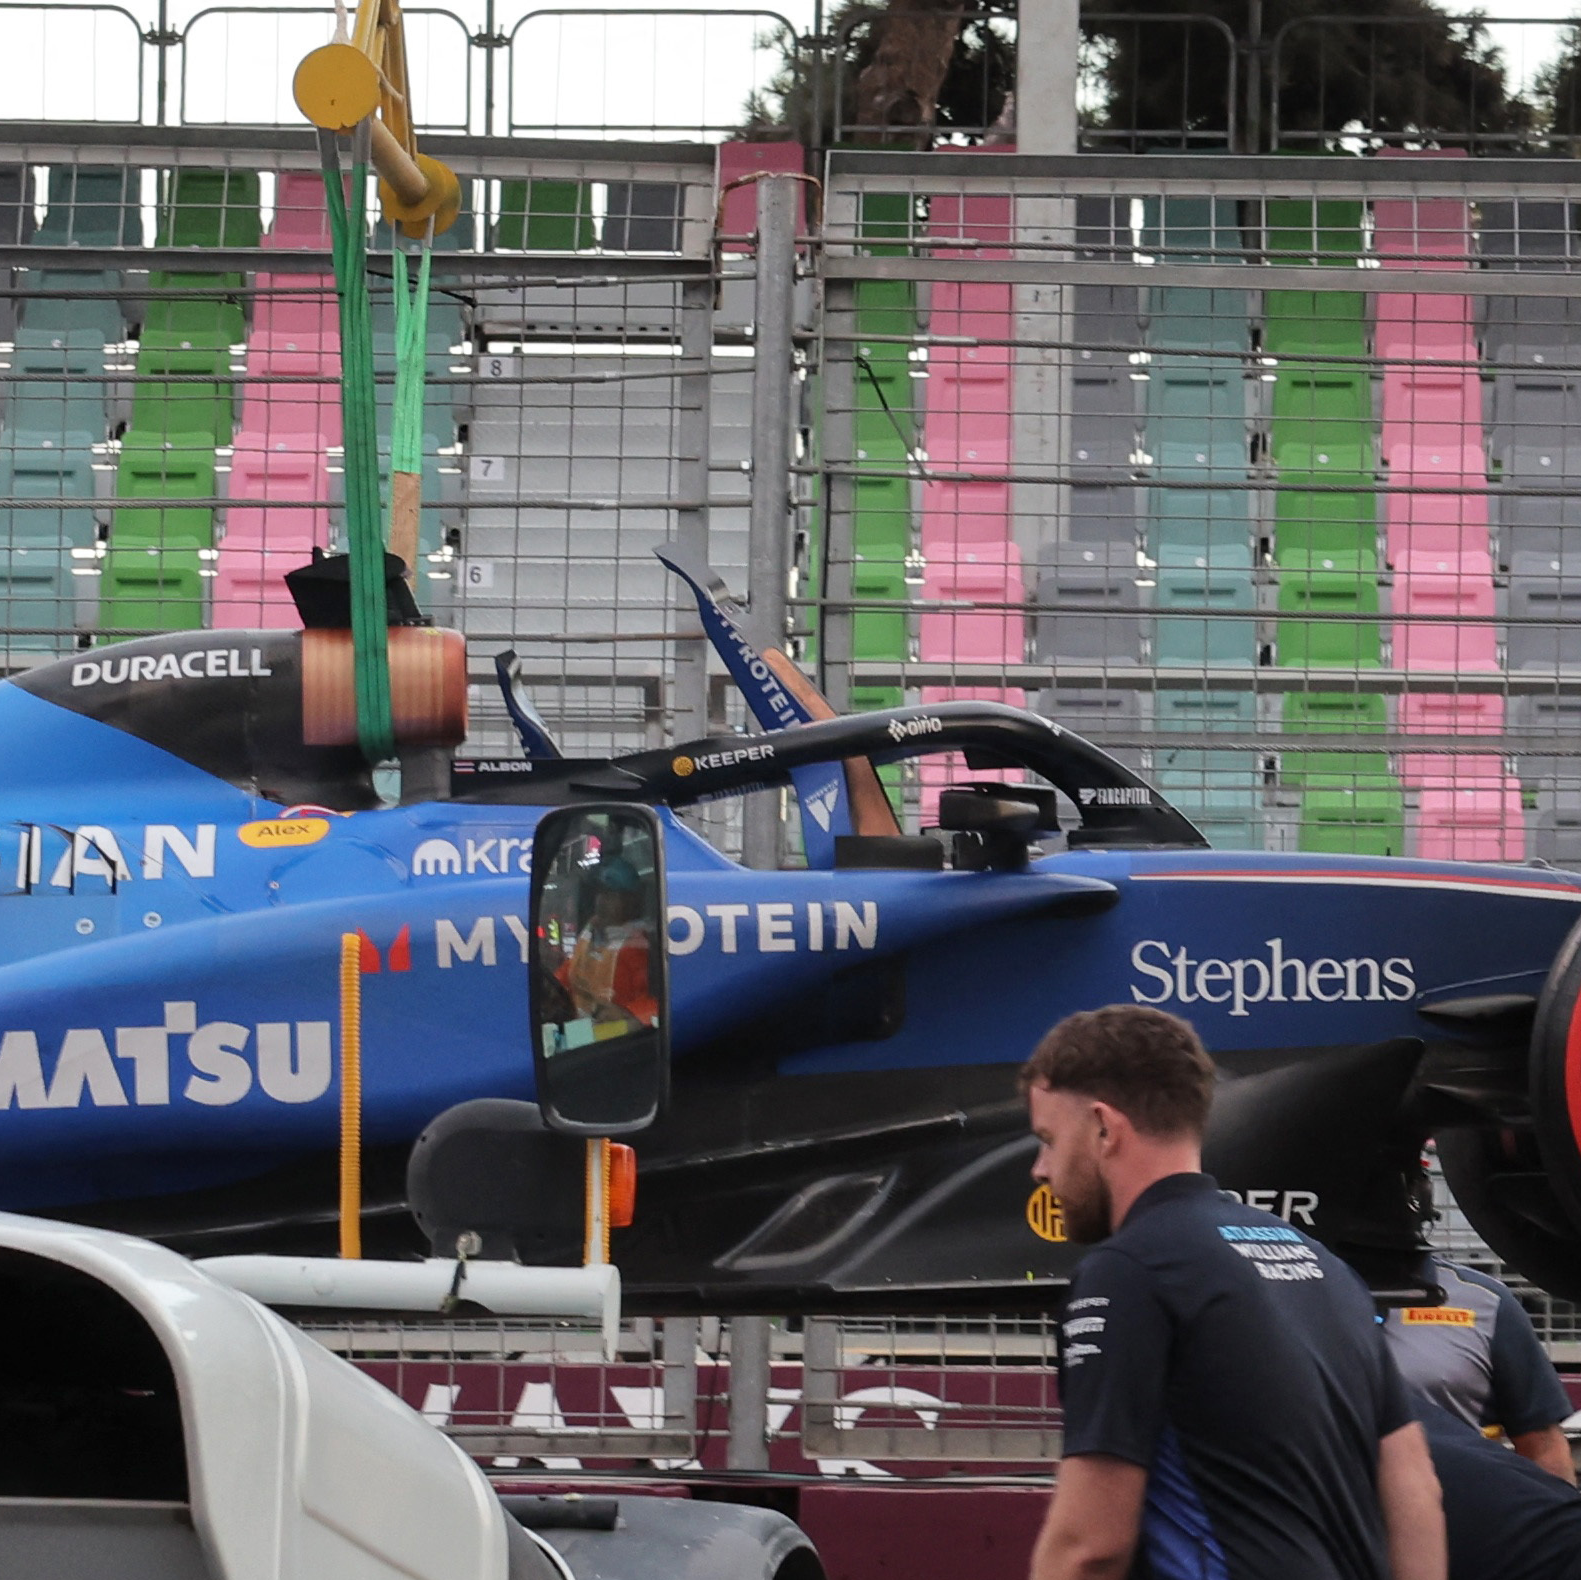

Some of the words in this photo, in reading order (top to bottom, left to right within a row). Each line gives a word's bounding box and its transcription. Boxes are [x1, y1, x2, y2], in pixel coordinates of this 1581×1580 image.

[491, 359, 502, 376] 8
[480, 460, 493, 477] 7
[470, 567, 482, 583] 6
[71, 648, 272, 688] DURACELL
[694, 744, 774, 770] KEEPER
[478, 761, 532, 773] ALBON
[256, 823, 311, 841] Alex
[435, 900, 878, 970] MYOTEIN
[1129, 938, 1416, 1015] Stephens
[1229, 1243, 1319, 1261] WILLIAMS
[1253, 1261, 1324, 1281] RACING
